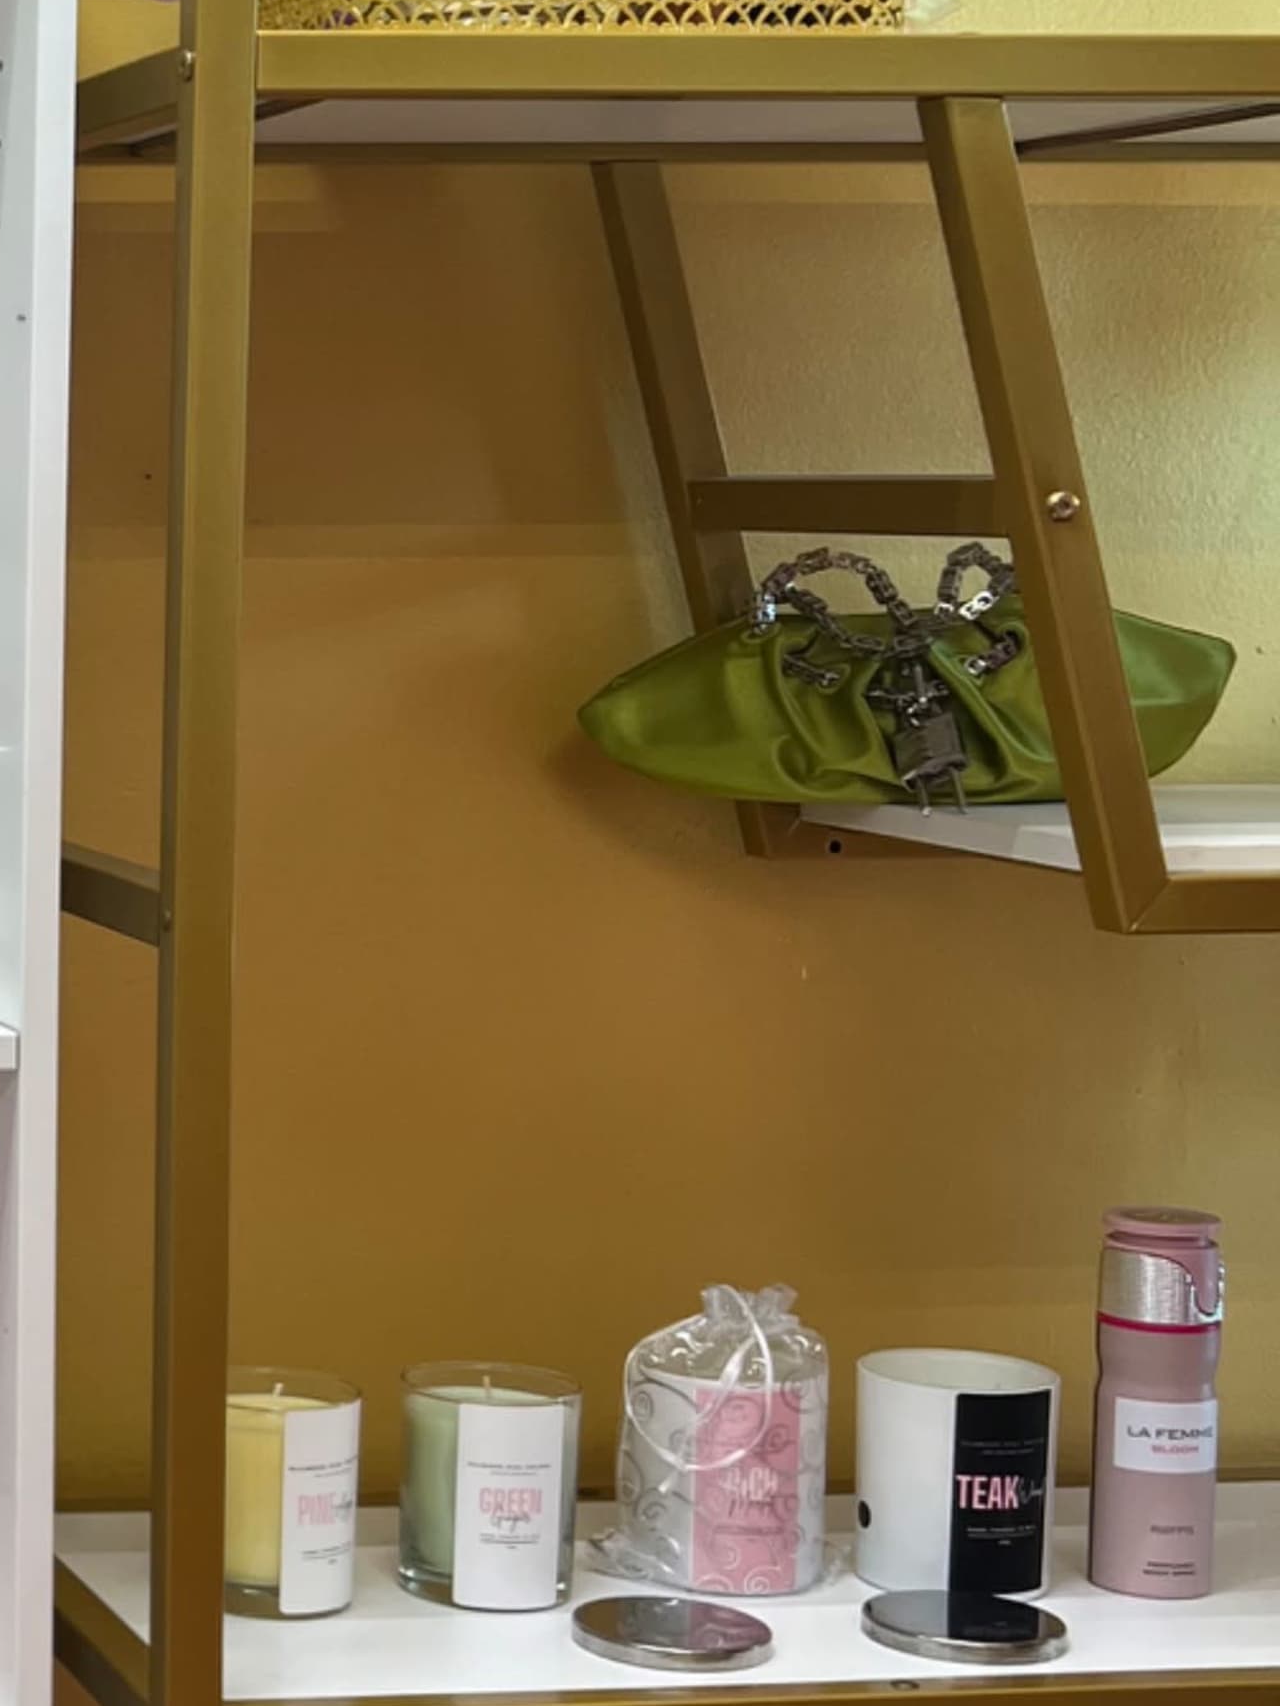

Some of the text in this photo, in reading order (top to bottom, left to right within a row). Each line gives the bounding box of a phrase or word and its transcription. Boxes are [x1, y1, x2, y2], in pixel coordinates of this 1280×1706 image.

[1127, 1425, 1213, 1441] LA FEMME
[479, 1487, 543, 1514] GREEN
[955, 1474, 1020, 1510] TEAK
